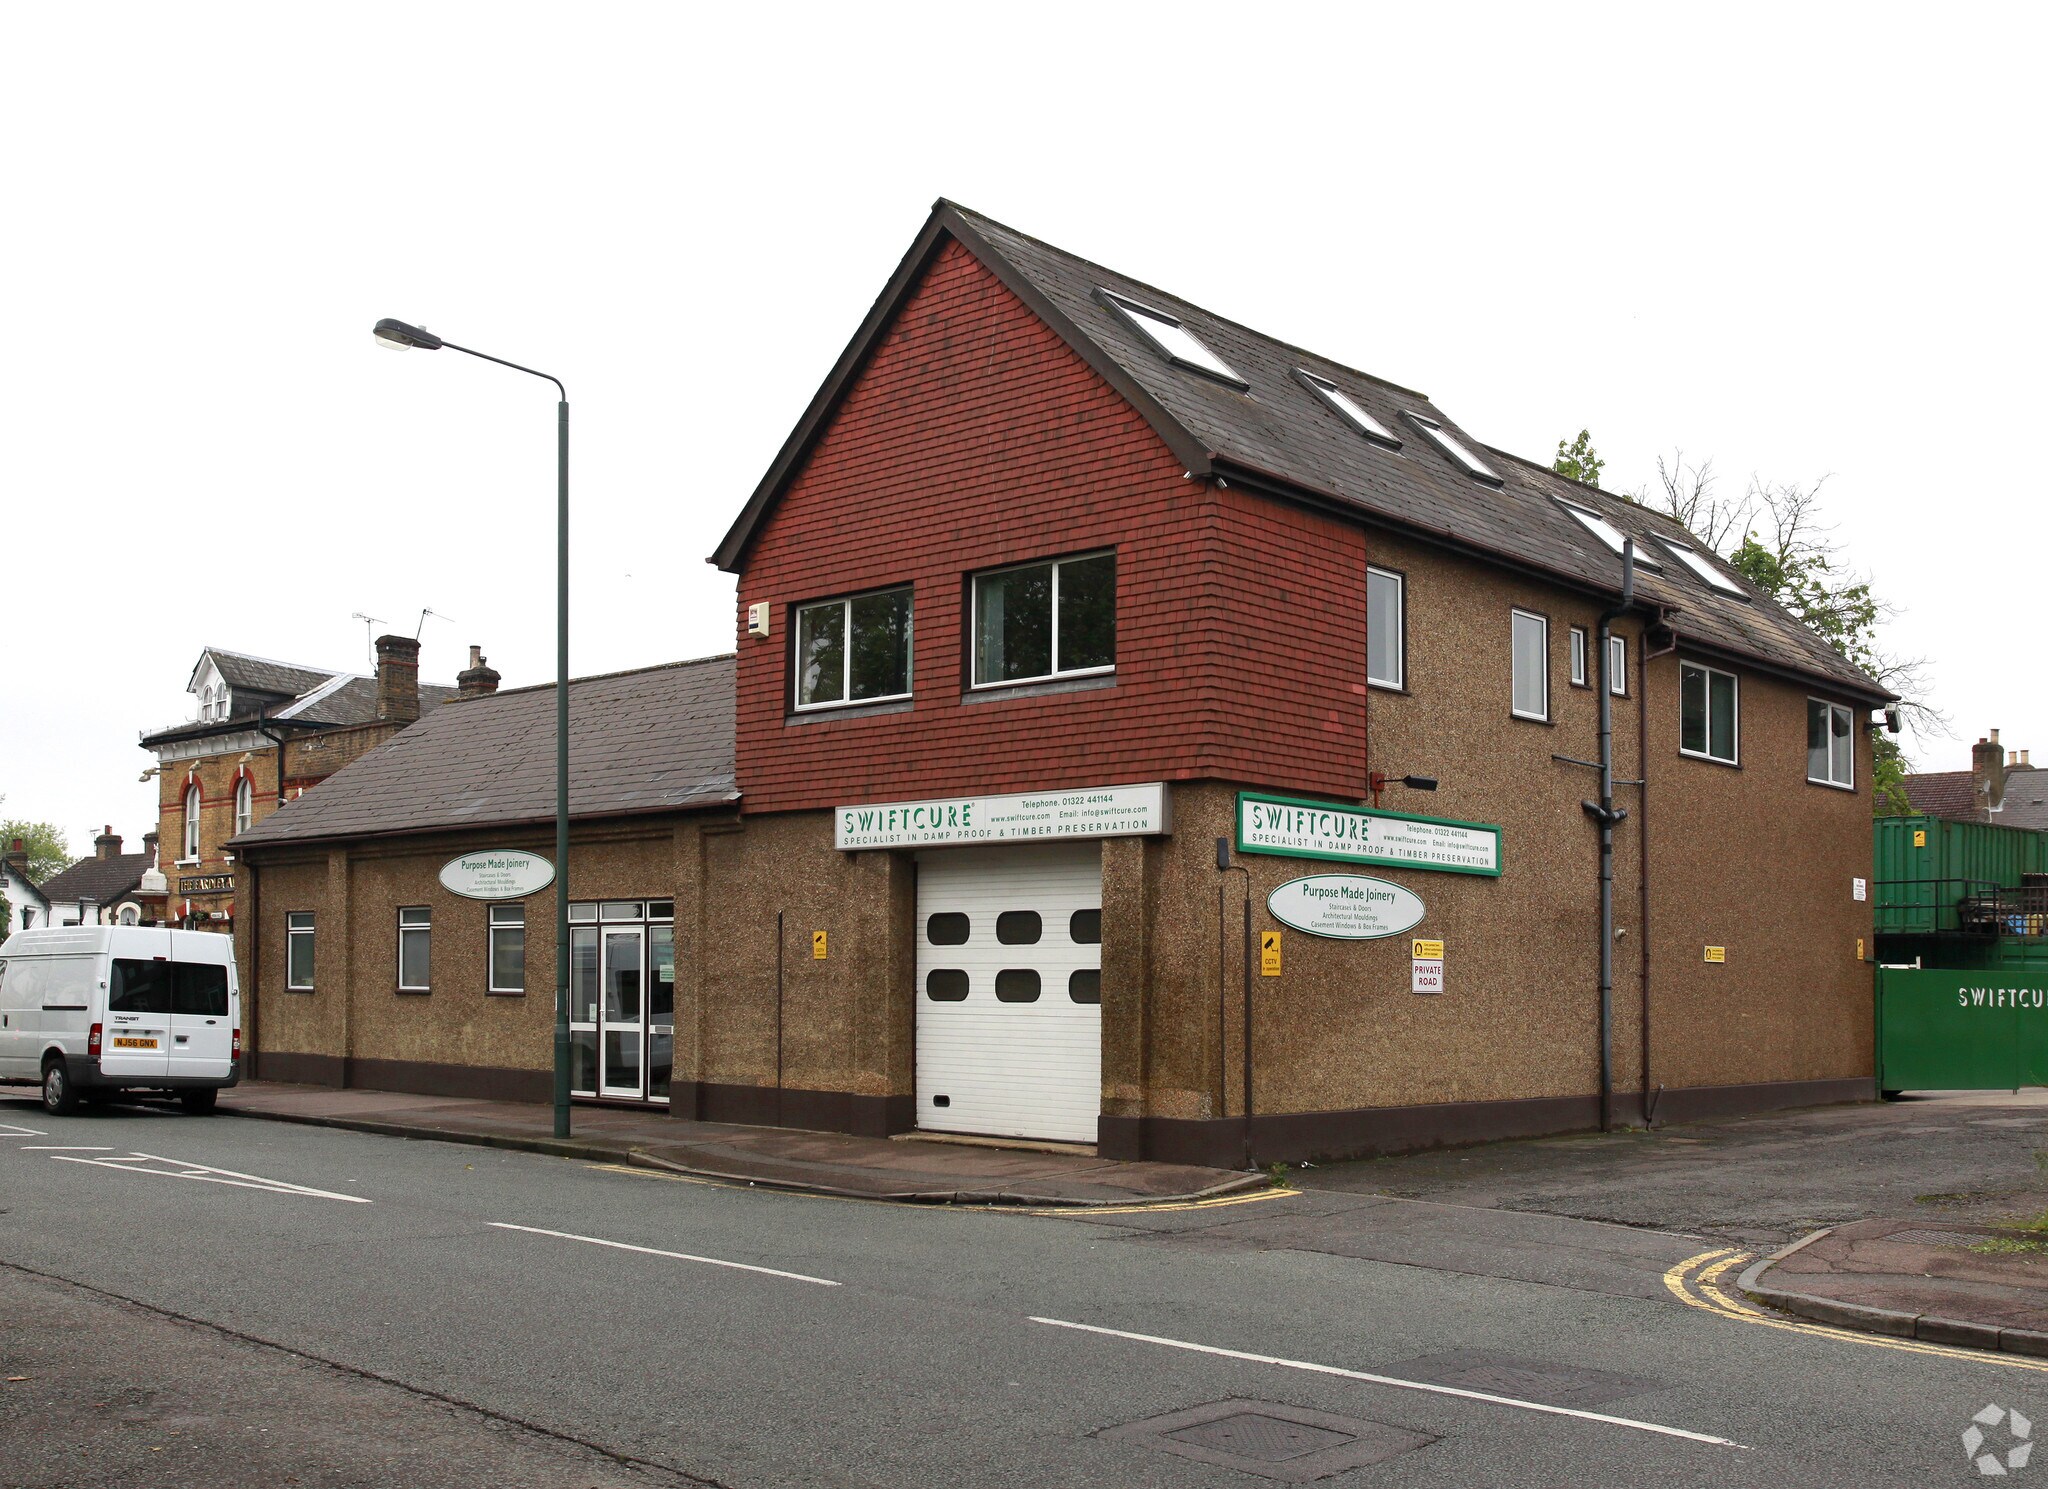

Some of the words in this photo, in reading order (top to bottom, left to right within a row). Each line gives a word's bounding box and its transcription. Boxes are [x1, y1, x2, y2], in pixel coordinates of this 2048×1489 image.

[1021, 800, 1061, 810] Telephone.
[1062, 796, 1084, 807] 01322
[1086, 794, 1113, 804] 441144
[844, 804, 972, 834] SWIFTCURE
[991, 813, 1051, 823] www.swiftcure.com
[1059, 810, 1079, 819] Email:
[1081, 806, 1148, 818] info@swiftcure.com
[1252, 805, 1369, 841] SWIFTCURE
[844, 834, 901, 845] SPECIALIST
[907, 833, 918, 842] IN
[924, 832, 951, 840] DAMP
[957, 829, 992, 839] PROOF
[999, 829, 1005, 837] &
[1011, 826, 1052, 836] TIMBER
[1057, 820, 1148, 833] PRESERVATION
[1406, 824, 1434, 836] Telephone.
[1434, 828, 1450, 837] 01322
[1450, 830, 1468, 839] 441144
[1252, 833, 1308, 847] SPECIALIST
[1314, 840, 1323, 848] IN
[1328, 841, 1352, 851] DAMP
[1357, 844, 1384, 854] PROOF
[1389, 847, 1394, 856] &
[1399, 849, 1428, 859] TIMBER
[1431, 853, 1489, 865] PRESERVATION
[1383, 835, 1427, 845] www.swiftcure.com
[1432, 839, 1446, 848] Email:
[1447, 840, 1489, 852] info@swiftcure.com
[461, 860, 487, 872] Purpose
[488, 859, 505, 869] Made
[505, 858, 530, 870] Joinery
[181, 879, 193, 891] THE
[1303, 883, 1339, 900] Purpose
[1341, 886, 1365, 900] Made
[1365, 888, 1396, 905] Joinery
[1328, 903, 1352, 911] Staircases
[1311, 920, 1335, 929] Casement
[1335, 921, 1357, 930] Windows
[1322, 912, 1353, 920] Architectural
[1354, 914, 1378, 923] Mouldings
[1414, 965, 1441, 975] PRIVATE
[1418, 977, 1438, 986] ROAD
[1958, 987, 2048, 1008] SWIFTCU
[117, 1038, 138, 1047] NJ56
[139, 1039, 155, 1047] GNX
